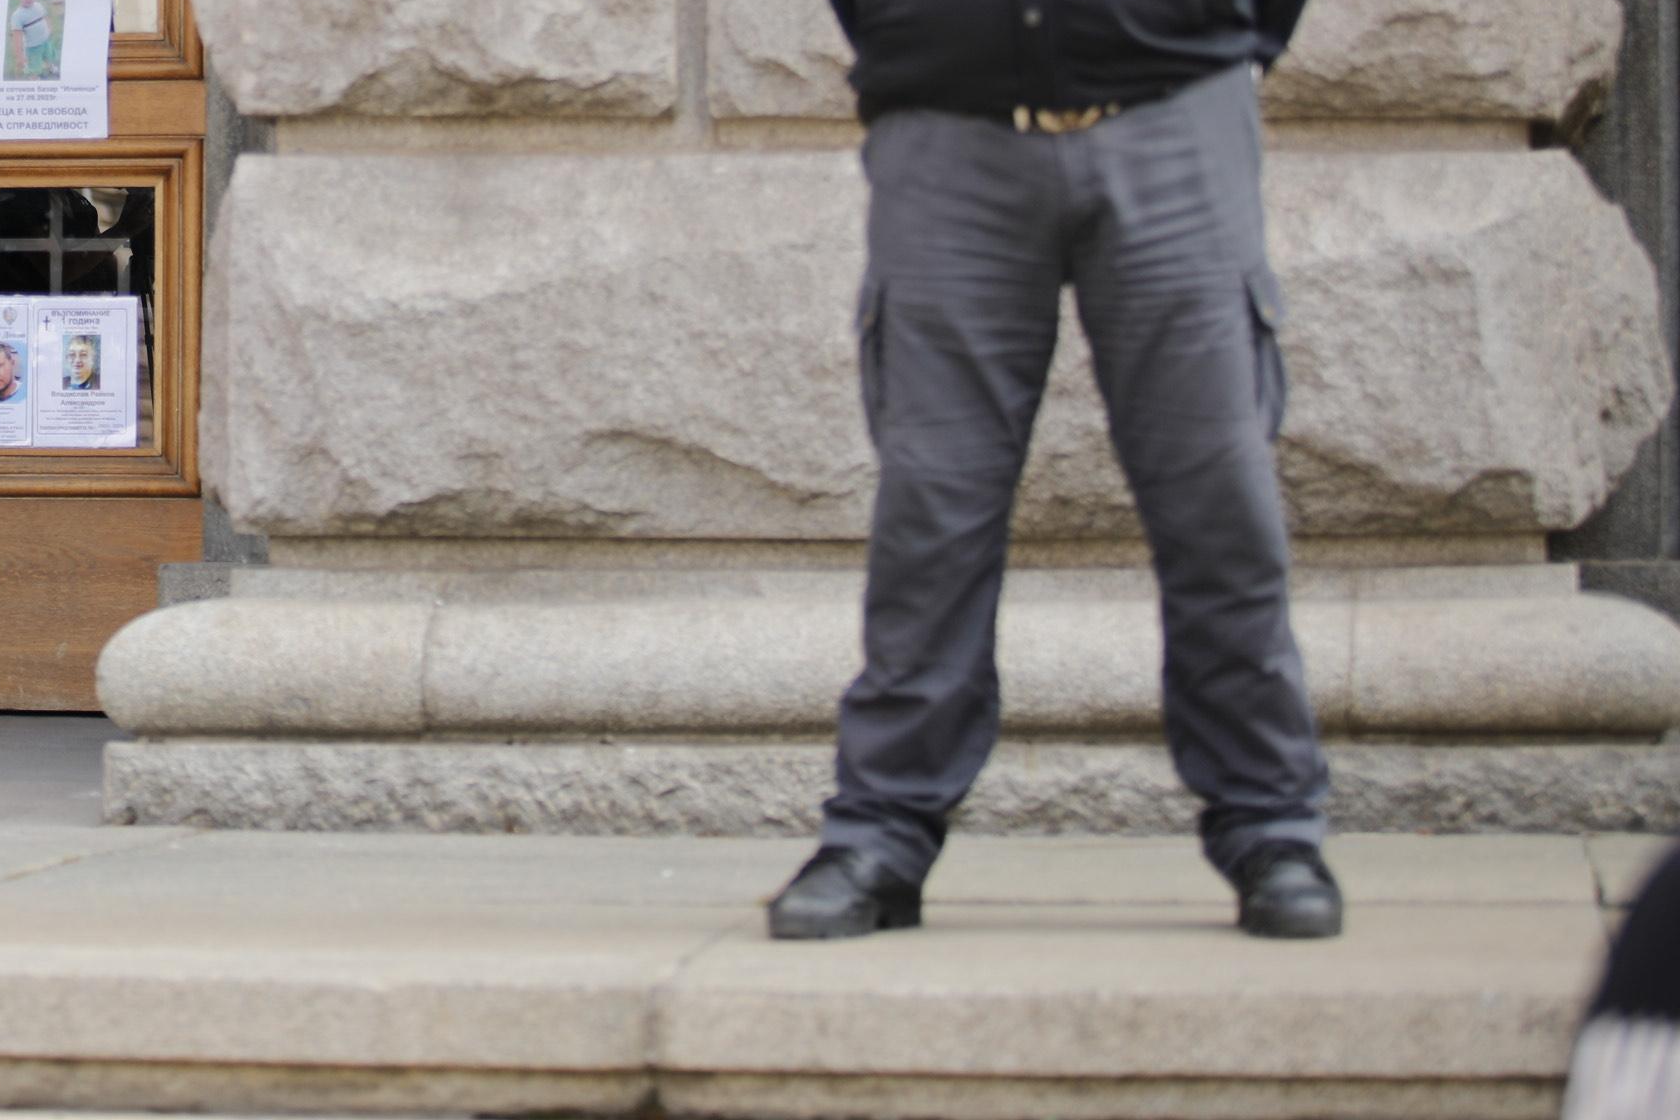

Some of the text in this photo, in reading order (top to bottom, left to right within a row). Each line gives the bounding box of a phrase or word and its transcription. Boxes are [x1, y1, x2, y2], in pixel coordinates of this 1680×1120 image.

[16, 107, 25, 116] Е
[25, 107, 39, 116] НА
[40, 106, 88, 117] СВОБОДА
[5, 121, 89, 131] СПРАВЕДЛИВОСТ
